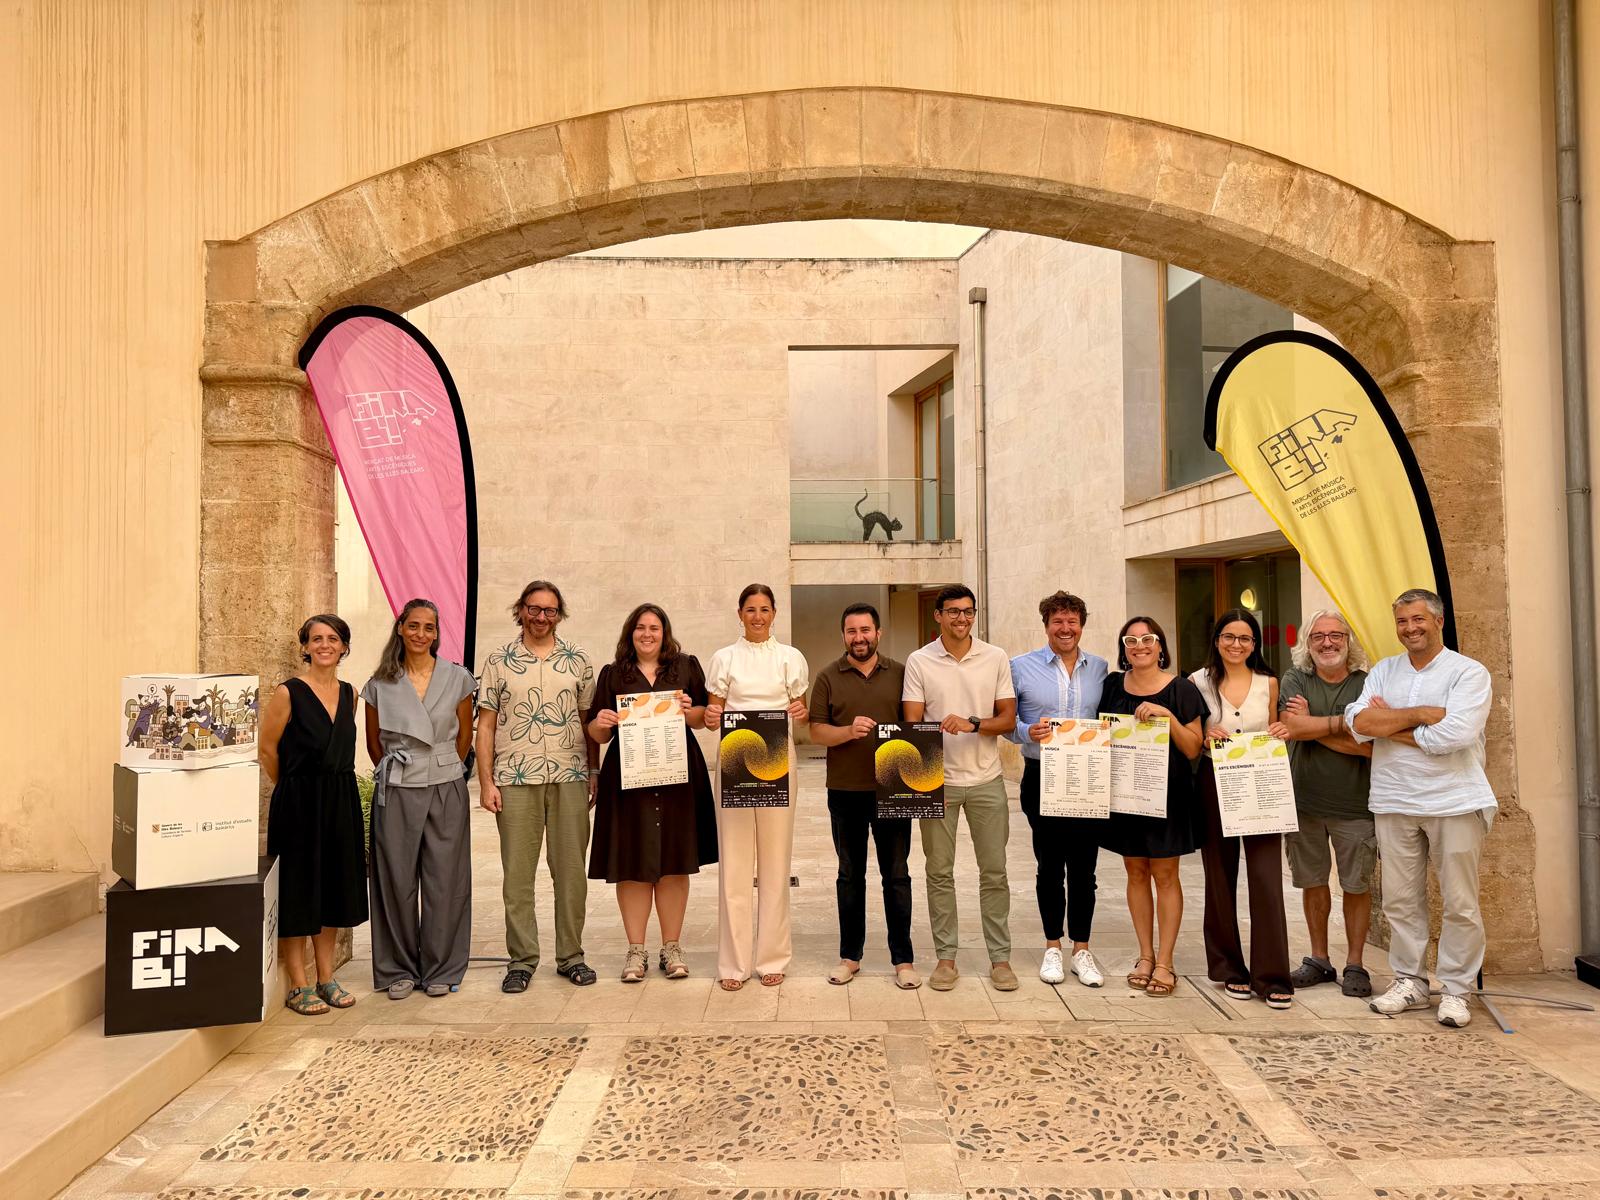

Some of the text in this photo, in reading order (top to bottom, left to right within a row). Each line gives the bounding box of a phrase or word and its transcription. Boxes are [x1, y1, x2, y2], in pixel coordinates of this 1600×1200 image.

[1291, 475, 1345, 506] MERCAT DE MÚSICA
[1299, 500, 1313, 512] ARTS
[1311, 483, 1347, 505] ESCÈNIQUES
[1306, 506, 1318, 516] LES
[1317, 499, 1332, 511] ILLES
[1330, 487, 1357, 503] BALEARS
[131, 954, 187, 990] B!
